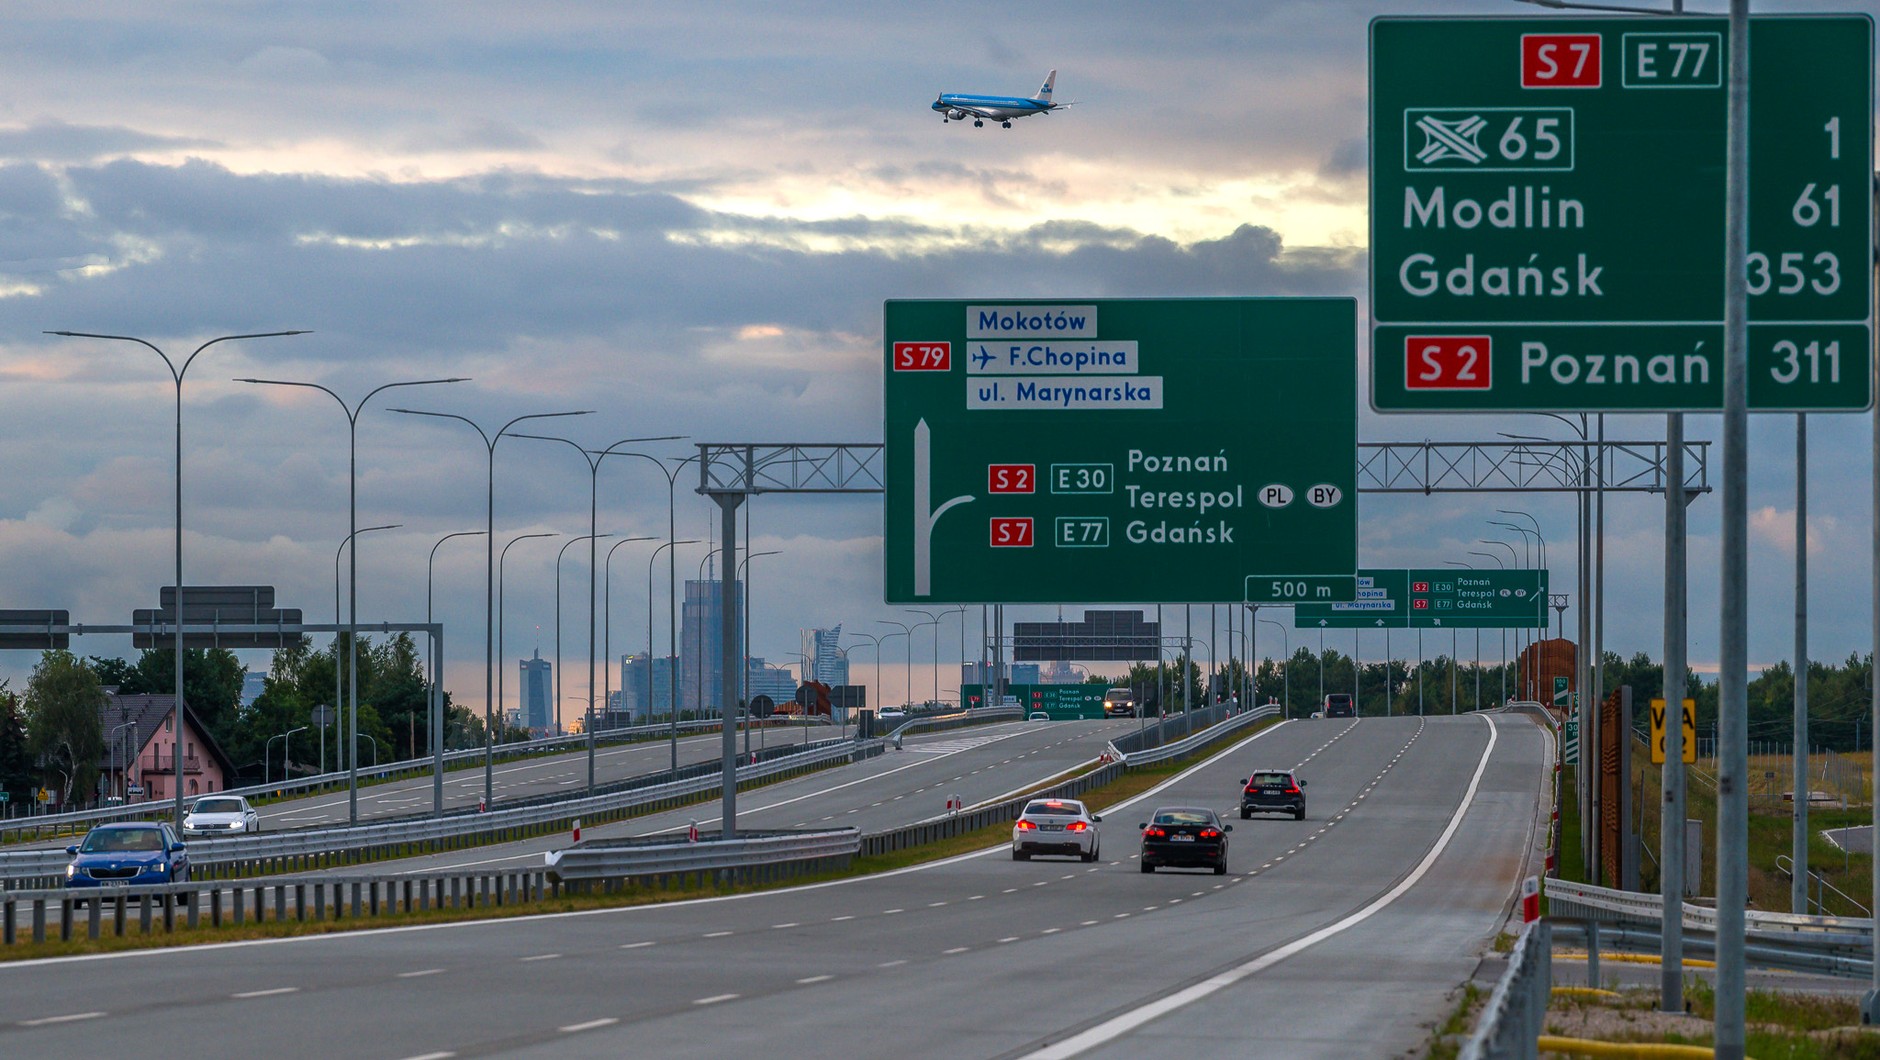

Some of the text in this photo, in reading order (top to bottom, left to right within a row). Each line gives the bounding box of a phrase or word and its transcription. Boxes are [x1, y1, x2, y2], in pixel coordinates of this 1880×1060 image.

[1500, 117, 1839, 160] 65 1
[1404, 183, 1839, 228] Modlin 61
[1399, 251, 1840, 296] Gdańsk 353
[980, 311, 1085, 330] Mokotów
[1010, 346, 1126, 368] F.Chopina
[1522, 340, 1839, 384] Poznań 311
[979, 382, 1150, 404] ul. Marynarska
[1129, 449, 1227, 472] Poznań
[1125, 485, 1242, 514] Terespol
[1267, 489, 1287, 504] PL
[1314, 489, 1336, 504] BY
[1126, 521, 1233, 543] Gdańsk
[1272, 582, 1330, 596] 500 m
[1457, 577, 1490, 586] Poznań
[1457, 589, 1495, 599] Terespol
[1457, 600, 1492, 609] Gdańsk
[1347, 602, 1392, 610] Marynarska
